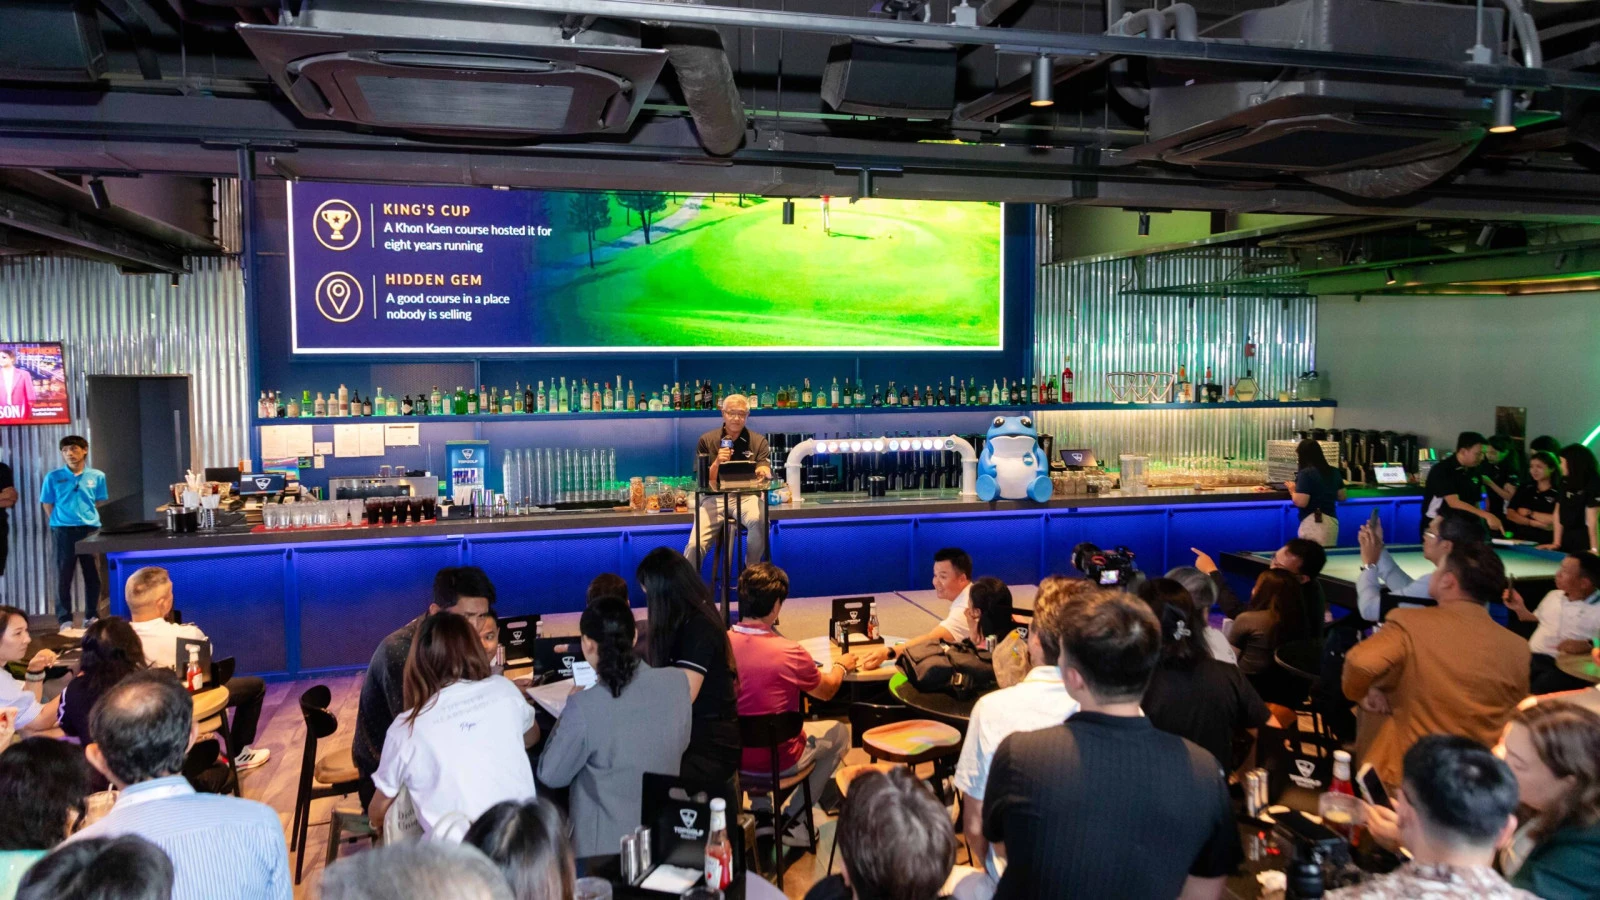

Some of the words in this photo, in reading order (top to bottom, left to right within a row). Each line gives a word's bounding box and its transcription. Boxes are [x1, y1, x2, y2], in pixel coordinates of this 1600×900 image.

[383, 203, 435, 216] KING'S
[441, 204, 471, 217] CUP
[383, 221, 394, 233] A
[395, 222, 424, 234] Khon
[426, 222, 453, 235] Kaen
[454, 225, 489, 235] course
[491, 224, 526, 236] hosted
[527, 225, 536, 236] it
[537, 225, 553, 237] for
[384, 238, 412, 252] eight
[413, 241, 443, 252] years
[444, 240, 484, 253] running
[385, 273, 445, 286] HIDDEN
[450, 274, 482, 286] GEM
[385, 292, 396, 304] A
[397, 292, 425, 306] good
[426, 295, 461, 304] course
[462, 292, 473, 304] in
[474, 295, 482, 304] a
[483, 293, 511, 306] place
[386, 308, 427, 322] nobody
[428, 308, 438, 320] is
[439, 308, 473, 322] selling
